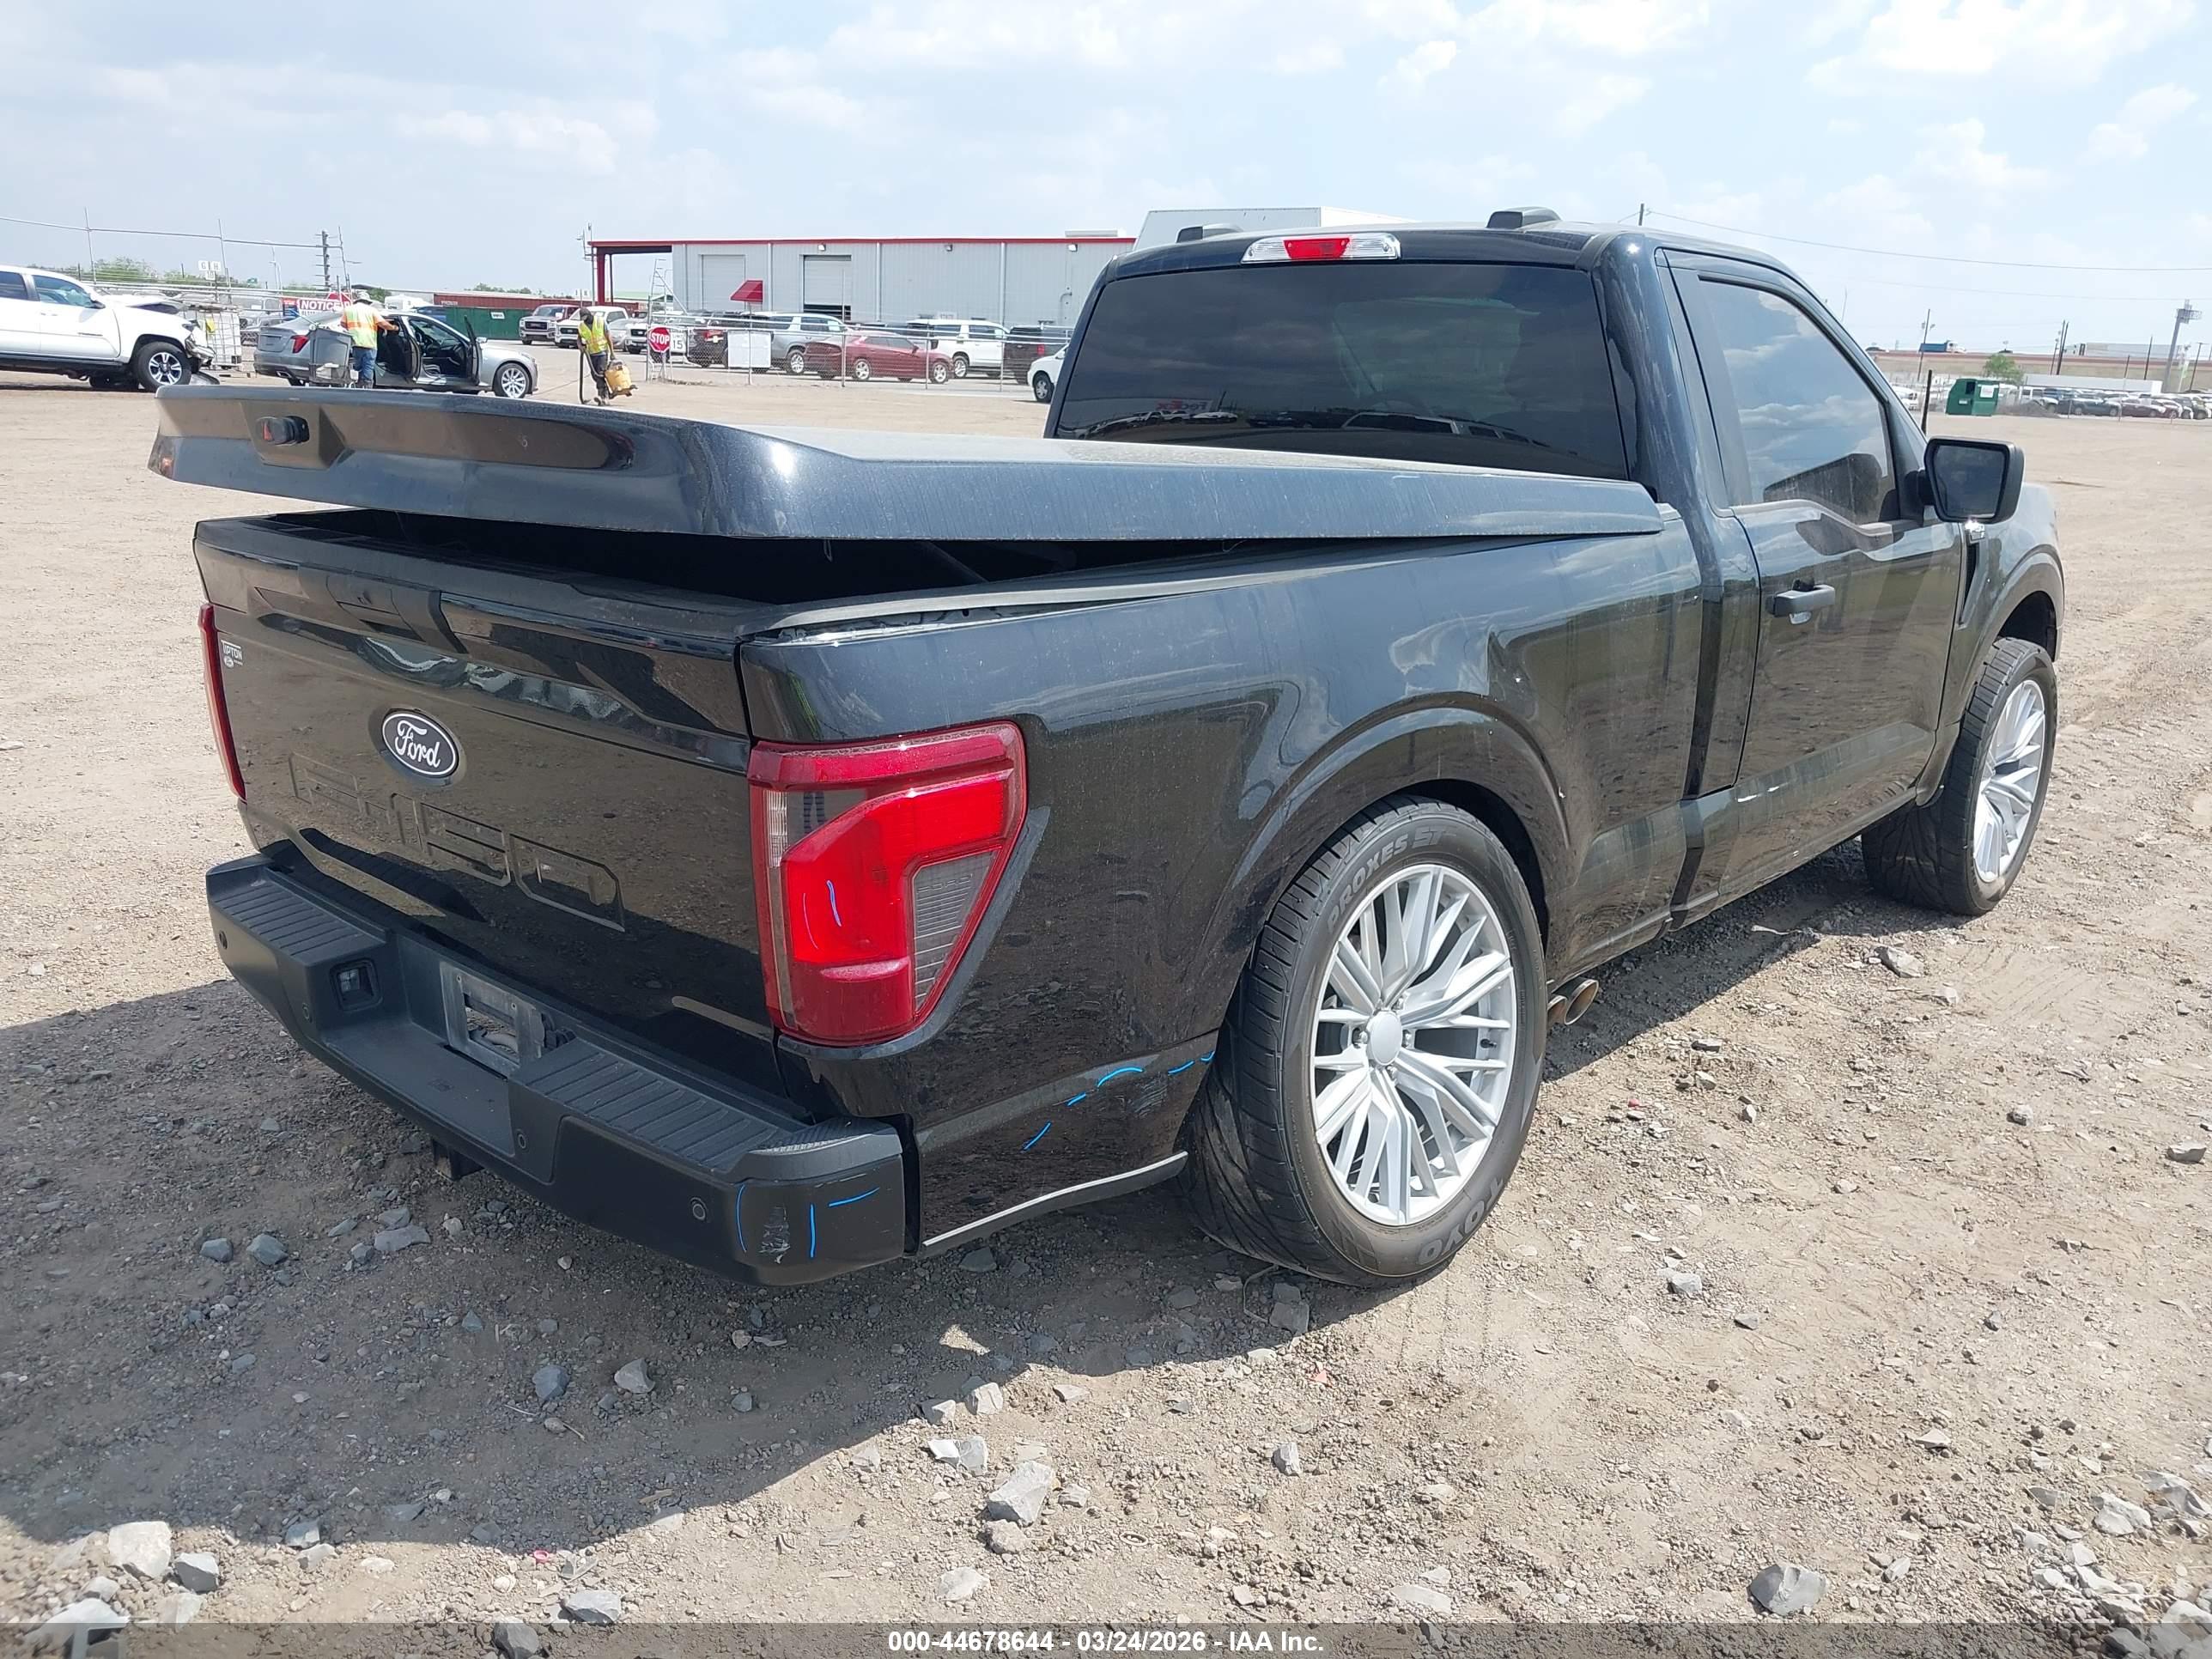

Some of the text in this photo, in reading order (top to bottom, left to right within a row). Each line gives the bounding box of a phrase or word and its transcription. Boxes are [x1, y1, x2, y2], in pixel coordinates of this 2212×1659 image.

[301, 301, 343, 311] NOTICE
[651, 332, 670, 345] STOP
[673, 340, 683, 349] 15
[394, 720, 441, 768] Ford
[1328, 834, 1408, 929] PROXES
[1417, 1177, 1504, 1266] TOYO
